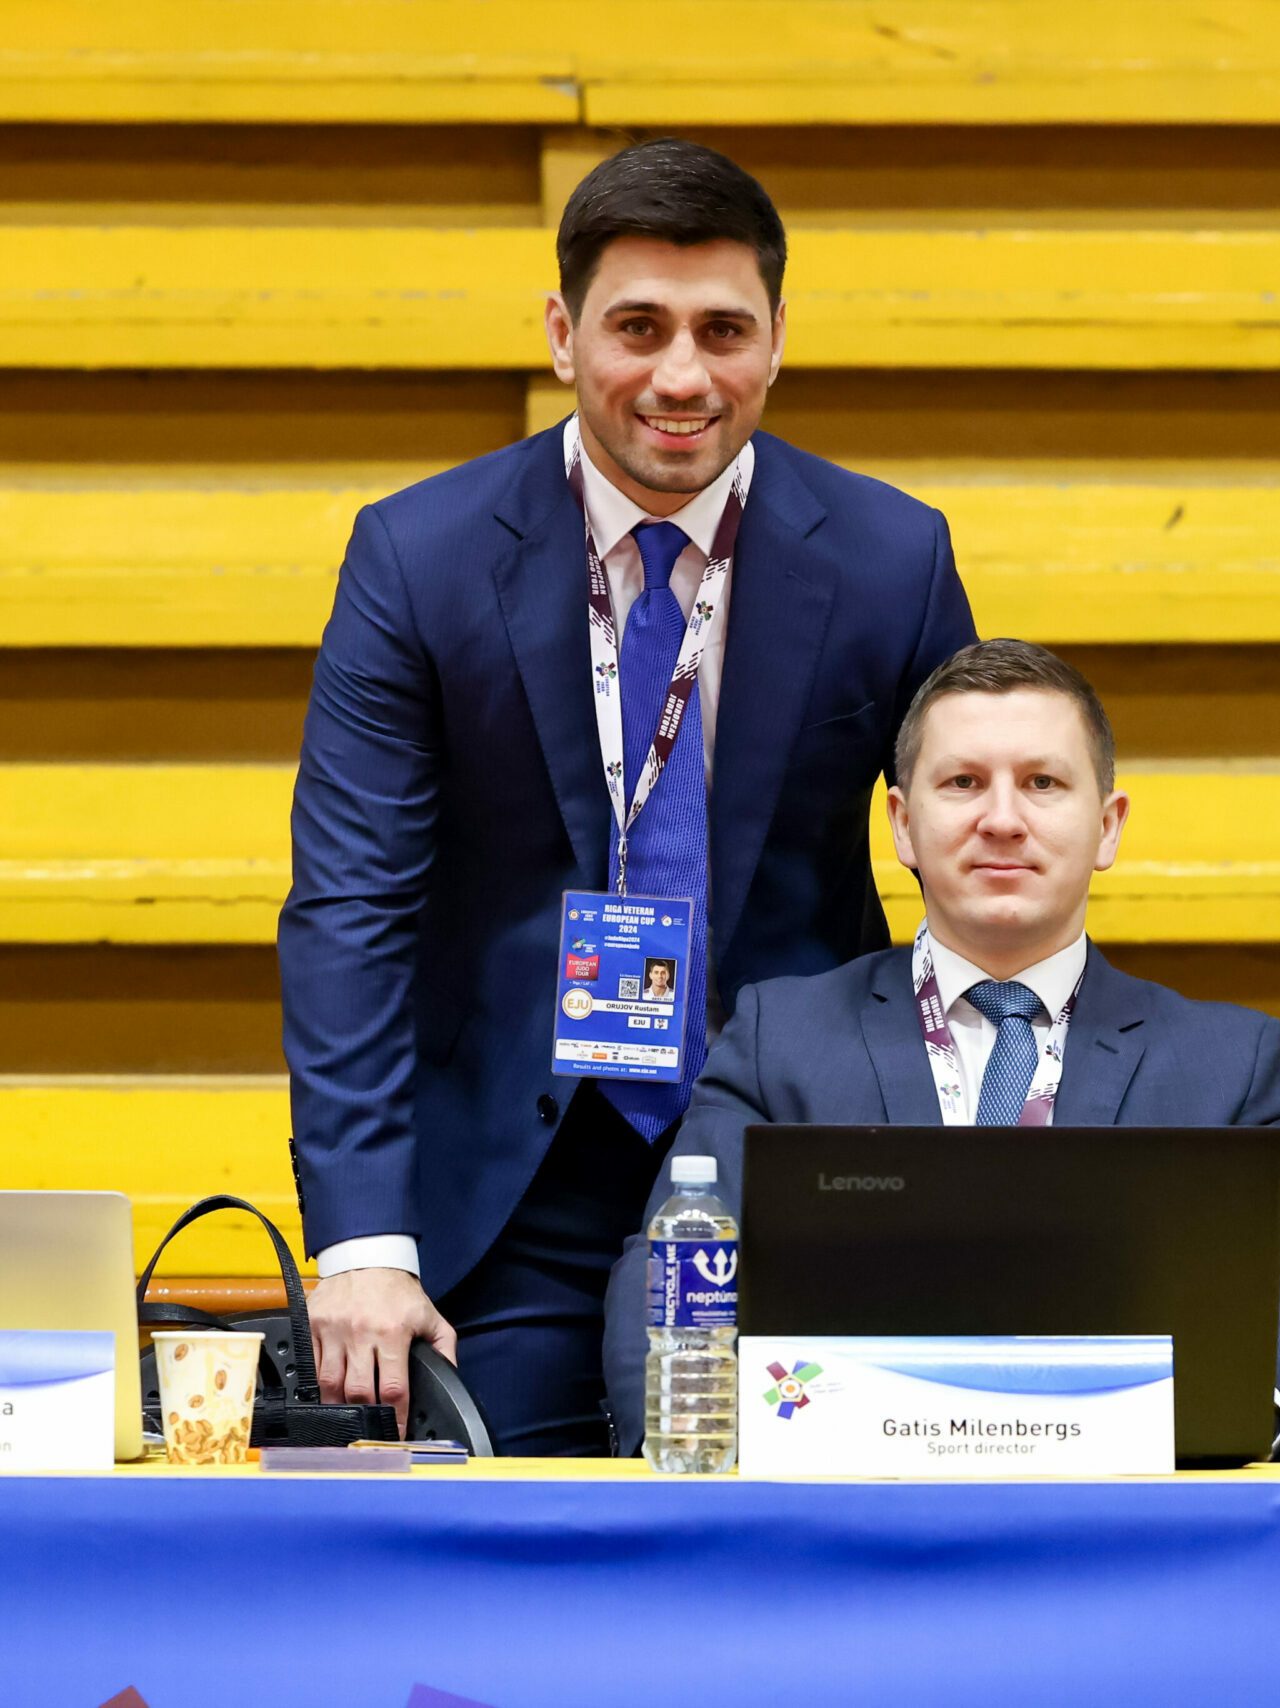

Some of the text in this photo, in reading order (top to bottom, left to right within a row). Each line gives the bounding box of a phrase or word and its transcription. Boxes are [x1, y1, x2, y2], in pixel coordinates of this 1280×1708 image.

[591, 574, 599, 596] TOUR
[593, 555, 607, 596] EUROPEAN
[658, 693, 677, 737] JUDO TOUR
[666, 698, 685, 740] EUROPEAN
[602, 914, 639, 924] EUROPEAN
[640, 917, 656, 926] CUP
[604, 904, 655, 916] RIGA VETERAN
[619, 925, 638, 934] 2024
[567, 999, 589, 1010] EJU
[606, 1003, 660, 1012] ORUJOV Rustam
[920, 998, 936, 1033] JUDO TOUR
[929, 994, 945, 1030] EUROPEAN
[818, 1173, 905, 1191] Lenovo
[665, 1243, 677, 1326] RECYCLE ME
[882, 1418, 1082, 1441] Gatis Milenbergs
[927, 1442, 1036, 1457] Sport director
